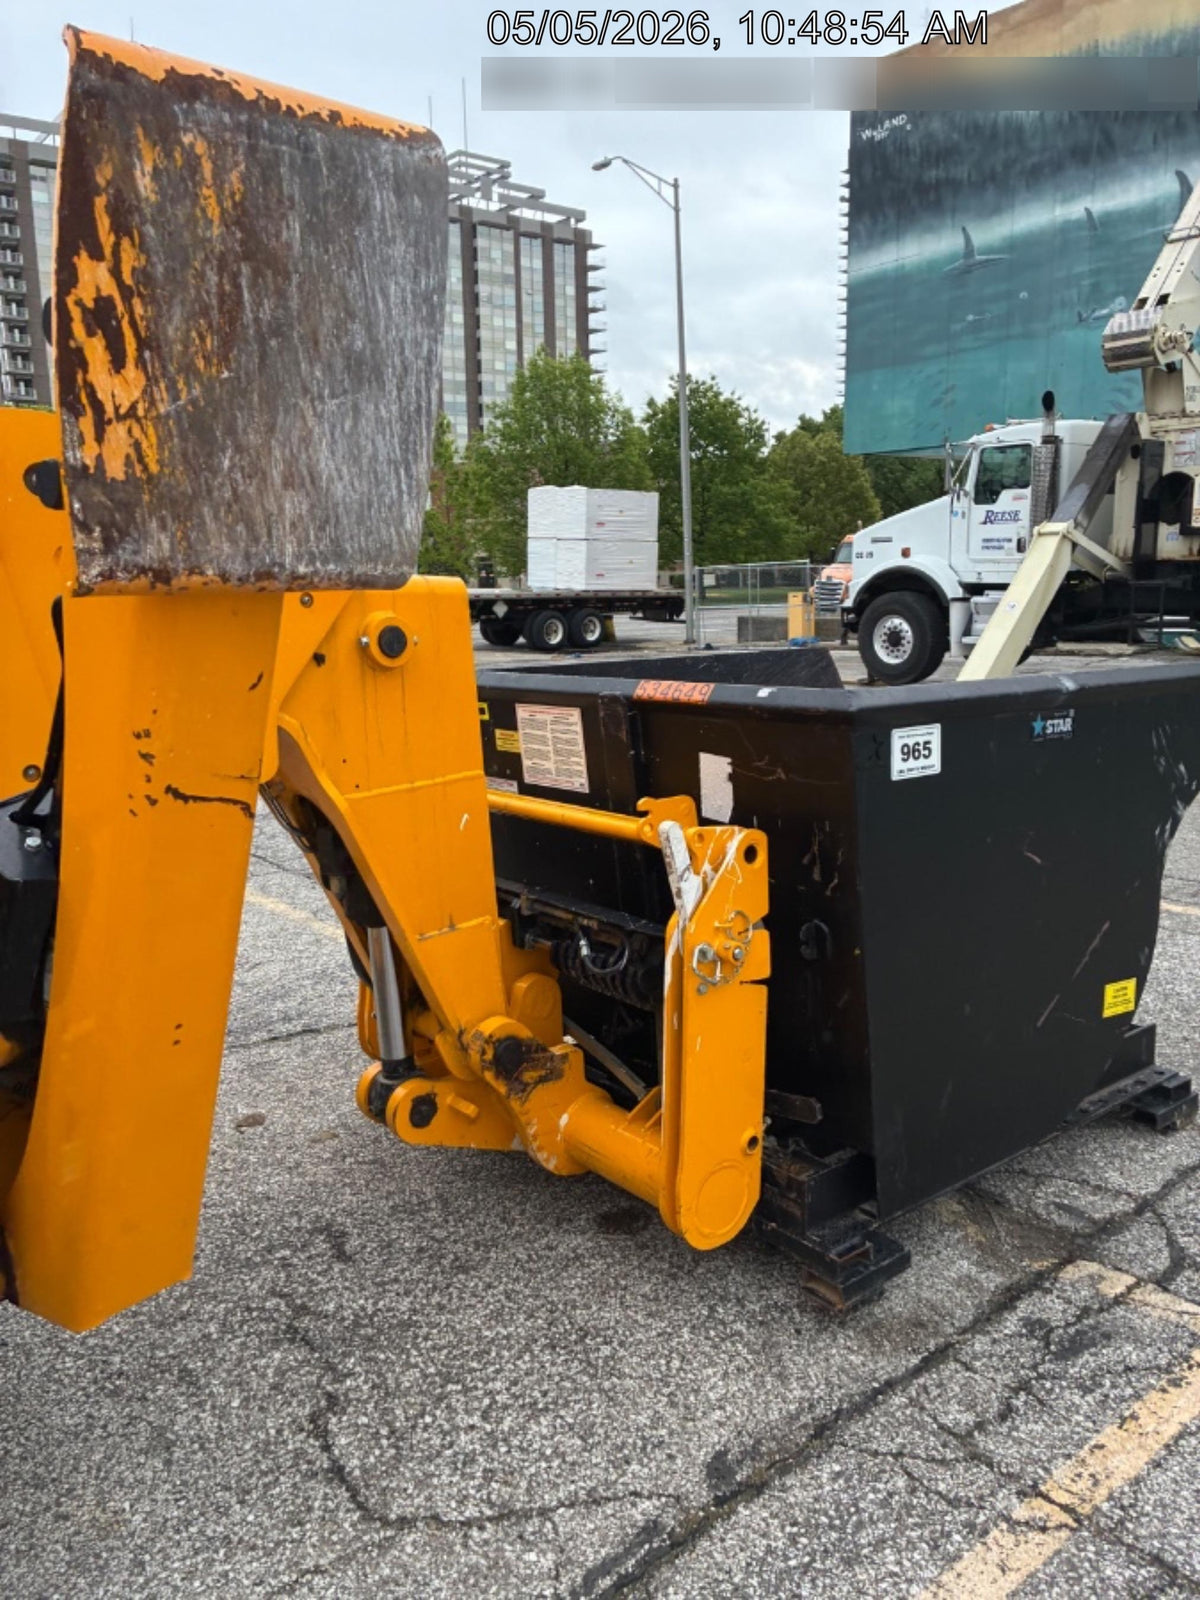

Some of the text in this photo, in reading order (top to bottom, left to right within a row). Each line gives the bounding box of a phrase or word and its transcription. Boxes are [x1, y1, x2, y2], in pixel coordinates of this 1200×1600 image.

[980, 509, 1022, 525] REESE
[1045, 718, 1073, 733] STAR
[900, 741, 932, 762] 965
